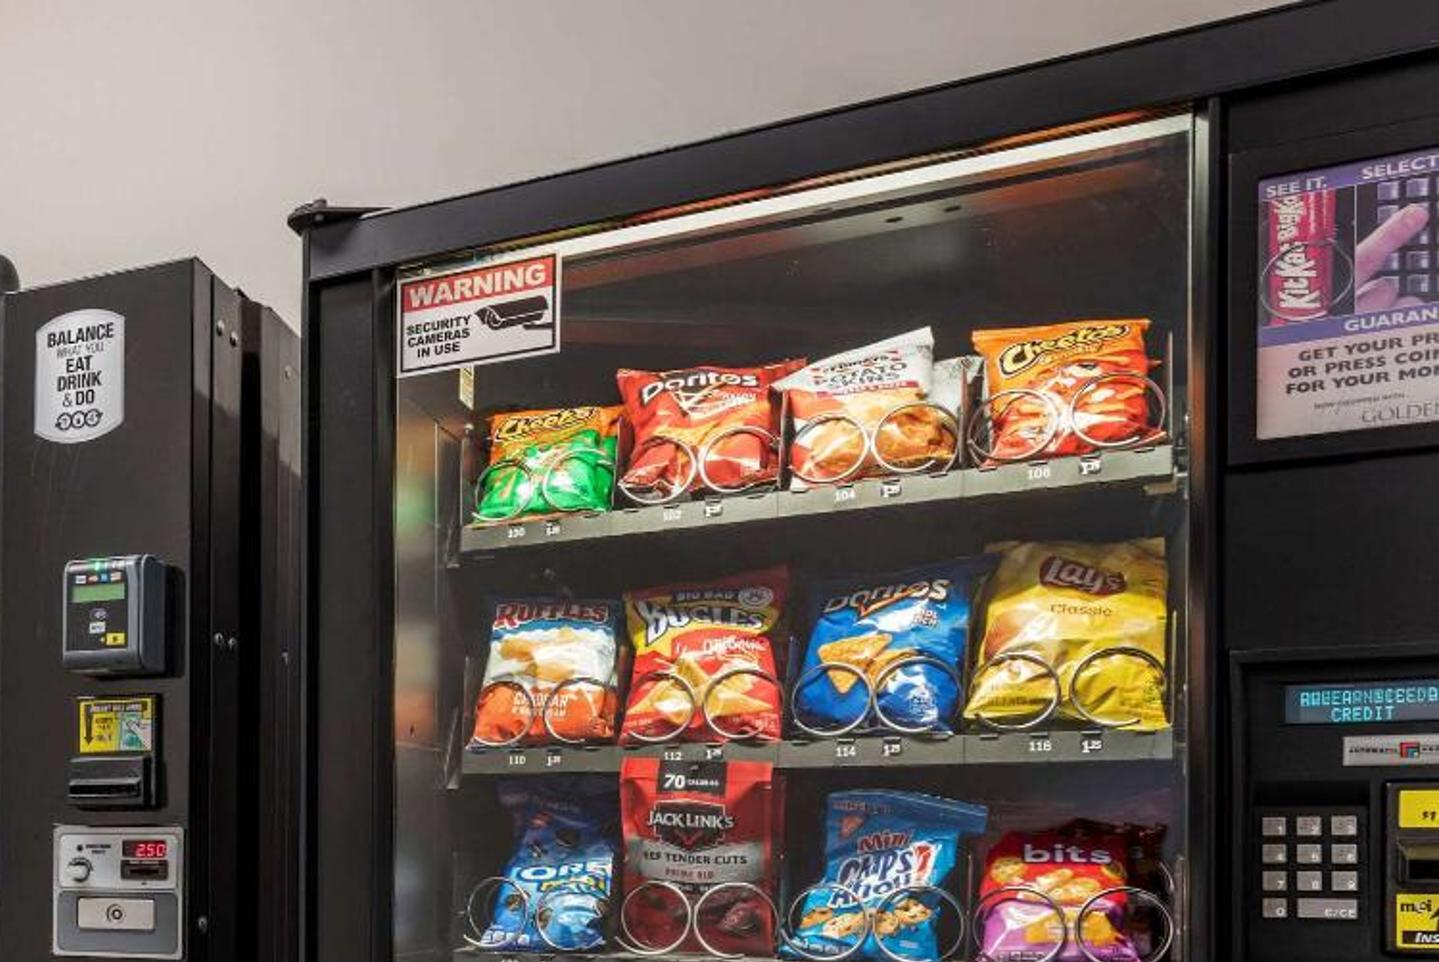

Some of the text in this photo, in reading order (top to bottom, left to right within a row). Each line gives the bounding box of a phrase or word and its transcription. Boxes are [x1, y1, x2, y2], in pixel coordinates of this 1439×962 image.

[1266, 182, 1301, 199] SEE
[411, 264, 546, 308] WARNING
[406, 314, 471, 336] SECURITY
[47, 321, 115, 349] BALANCE
[407, 328, 471, 348] CAMERAS
[417, 341, 461, 358] IN USE
[999, 325, 1129, 378] Cheetos
[1298, 347, 1337, 361] GET
[1344, 336, 1403, 355] YOUR
[66, 355, 93, 373] EAT
[1287, 365, 1317, 379] OR
[1324, 355, 1386, 374] PRESS
[56, 370, 102, 392] DRINK
[641, 373, 759, 404] Doritos
[1285, 379, 1325, 395] FOR
[1332, 371, 1389, 389] YOUR
[62, 389, 95, 408] & DO
[496, 604, 610, 630] RUFFLES
[1331, 706, 1394, 722] CREDIT
[665, 752, 682, 760] 112
[836, 747, 856, 757] 114
[663, 773, 686, 790] 70
[647, 809, 687, 828] JACK
[135, 842, 167, 858] 250
[665, 852, 748, 865] TENDER CUTS
[1023, 843, 1112, 864] bits
[1311, 851, 1320, 863] 5
[1276, 879, 1286, 890] 7
